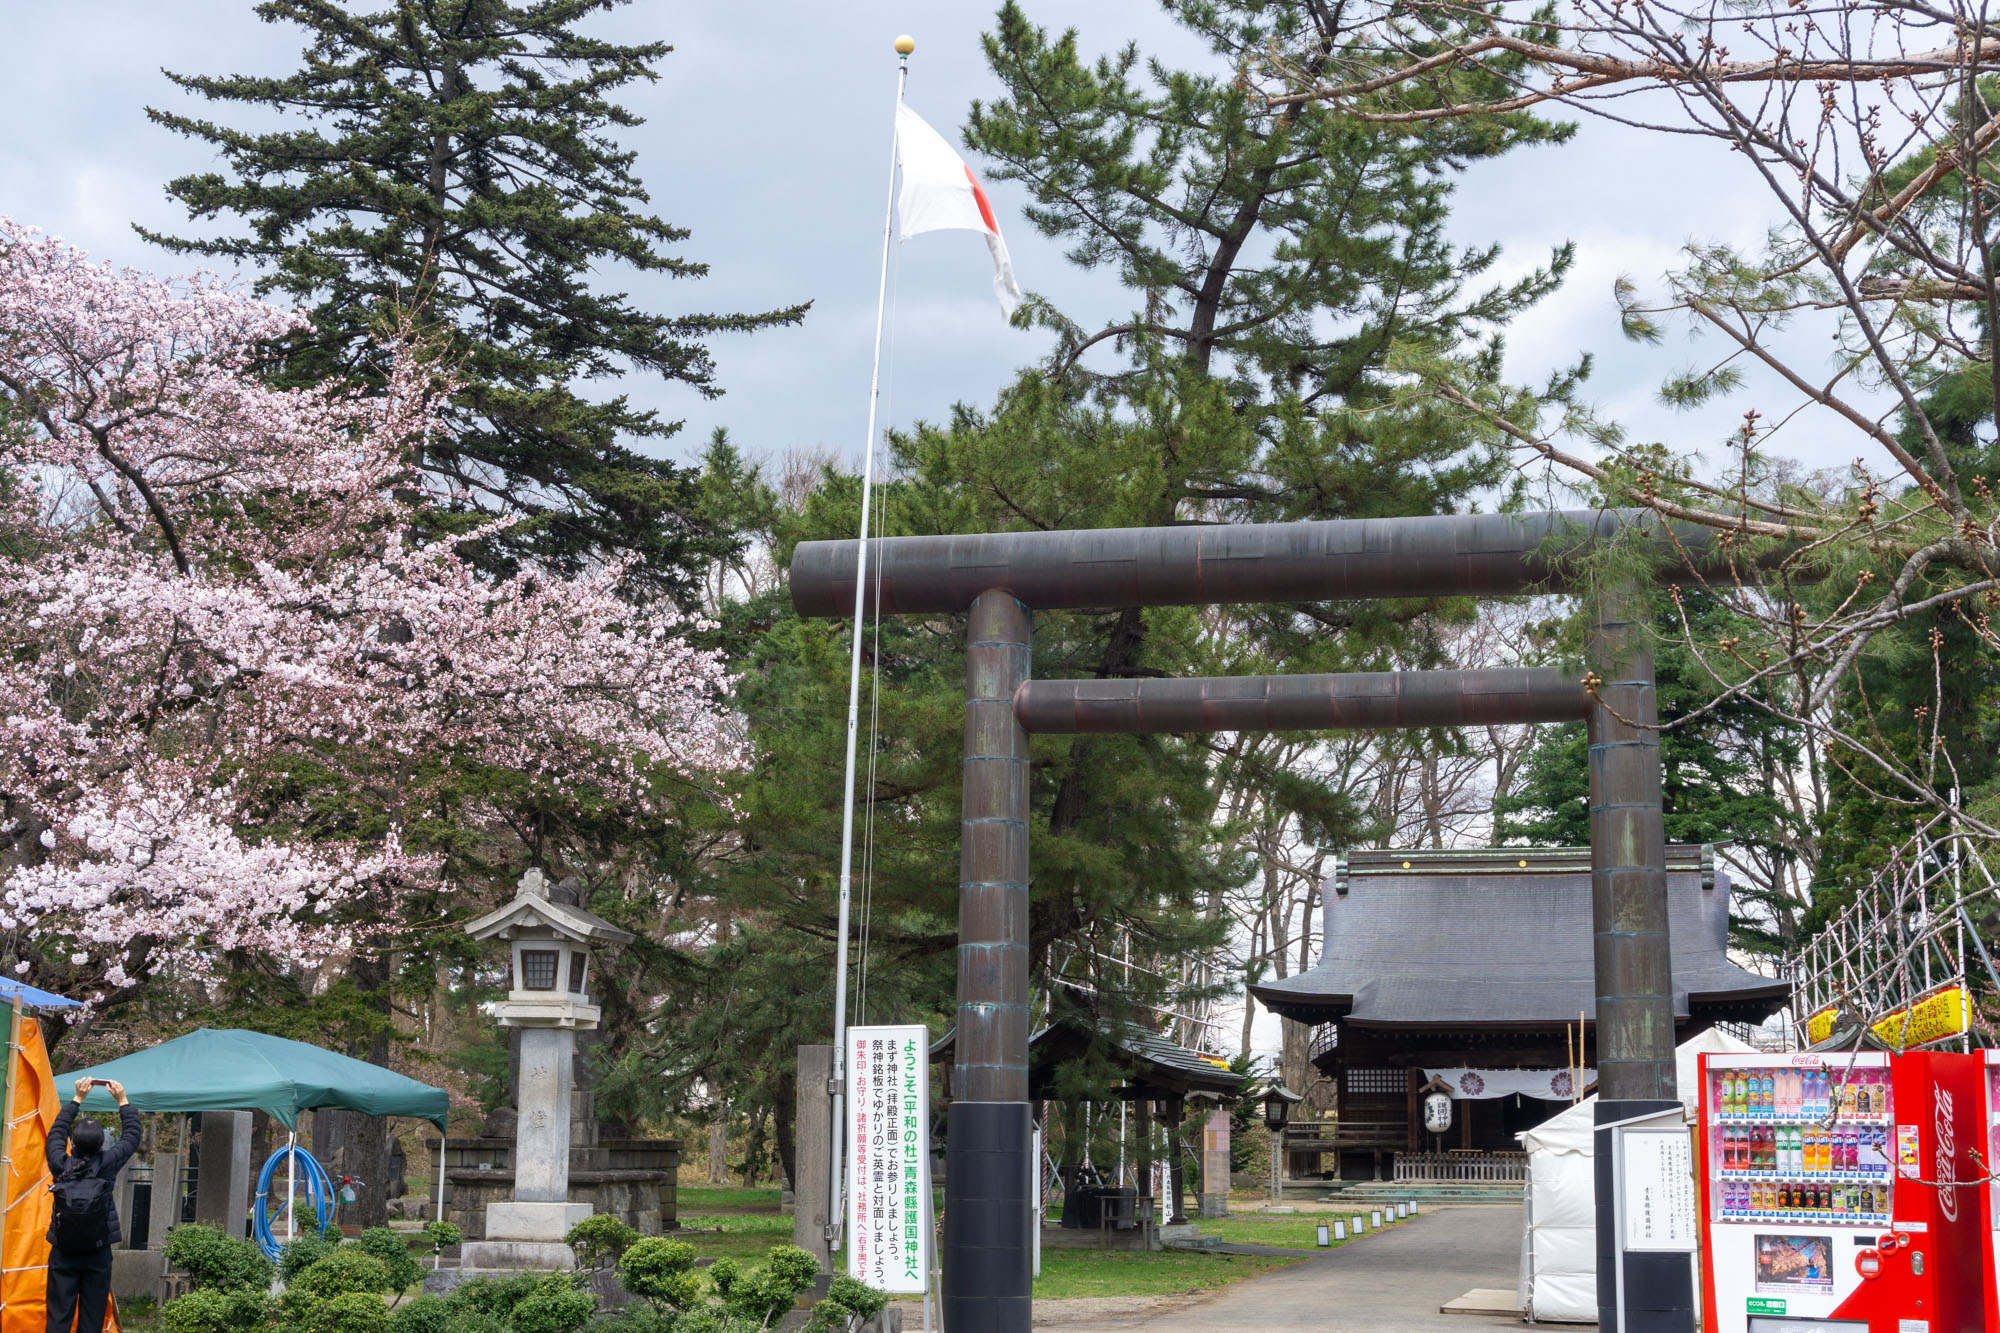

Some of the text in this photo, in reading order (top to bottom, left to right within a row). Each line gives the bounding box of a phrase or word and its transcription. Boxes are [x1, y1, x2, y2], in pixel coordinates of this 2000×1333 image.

[903, 1038, 918, 1280] ようこそ【平和の杜】青森縣護国神社へ
